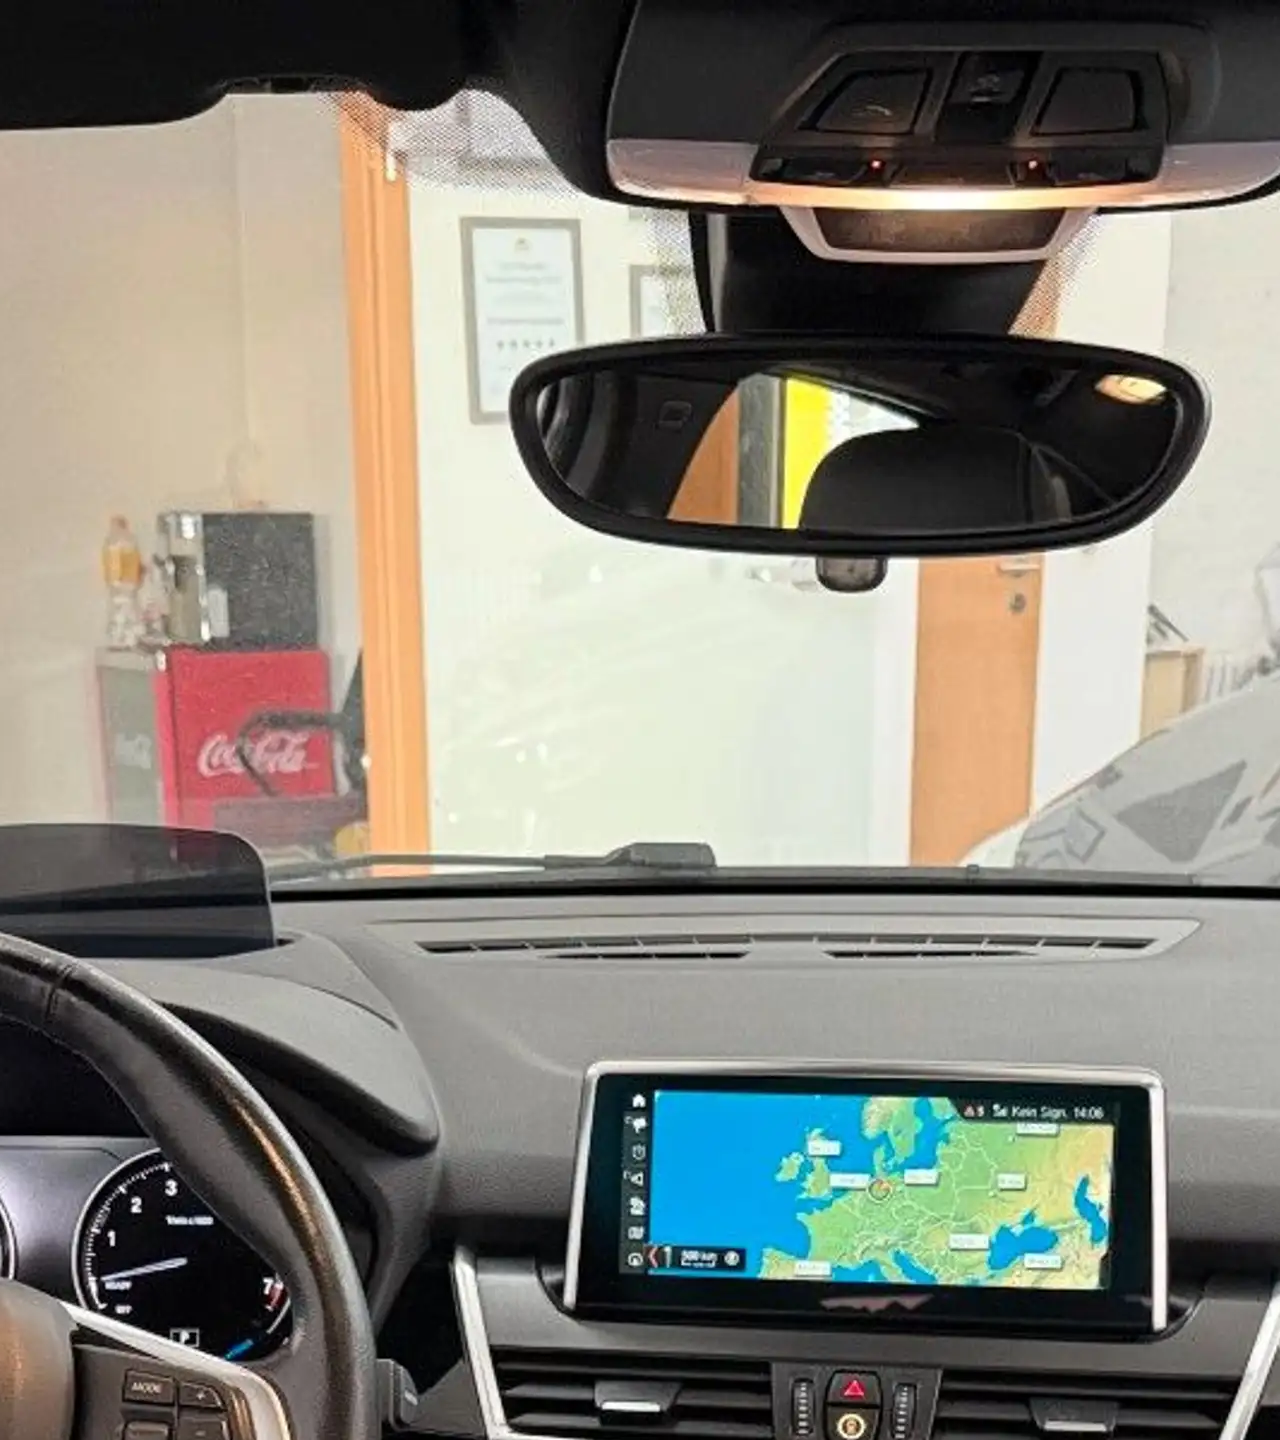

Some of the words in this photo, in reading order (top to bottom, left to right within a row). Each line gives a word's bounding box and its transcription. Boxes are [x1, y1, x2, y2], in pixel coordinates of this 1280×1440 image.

[165, 1179, 178, 1196] 3
[130, 1197, 142, 1214] 2
[107, 1230, 116, 1247] 1
[263, 1277, 274, 1295] 7
[131, 1381, 163, 1394] MODE
